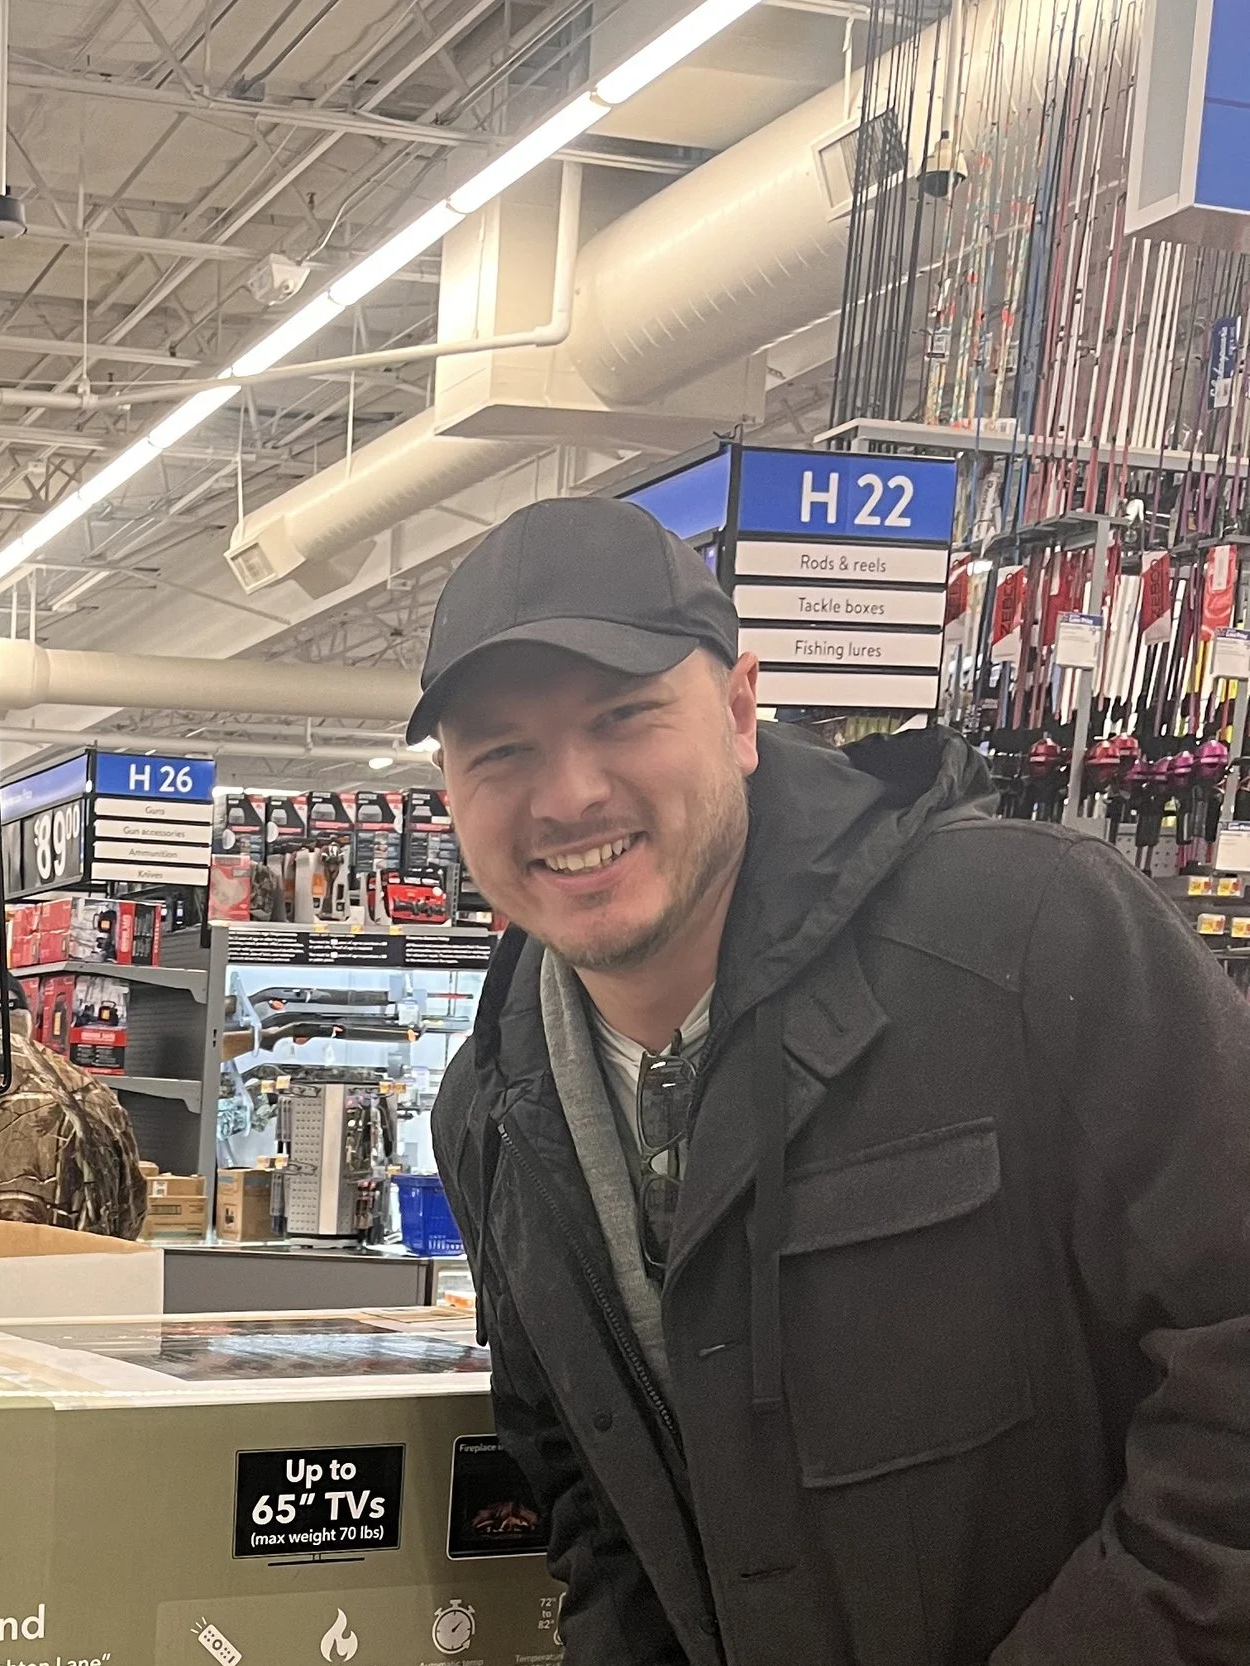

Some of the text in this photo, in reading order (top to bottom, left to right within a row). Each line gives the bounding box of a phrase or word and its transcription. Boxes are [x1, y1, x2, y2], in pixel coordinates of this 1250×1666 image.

[801, 471, 913, 526] H 22
[801, 555, 886, 572] Rods & reels
[798, 597, 884, 615] Tackle boxes
[795, 640, 881, 660] Fishing lures
[130, 764, 192, 792] H 26
[146, 806, 165, 815] Guns
[123, 827, 185, 838] Gun accessories
[129, 848, 178, 858] Ammunition
[137, 870, 163, 879] Knives
[287, 1459, 356, 1488] Up to
[325, 1490, 385, 1520] TVs
[251, 1525, 383, 1547] (max weight 70 lbs)
